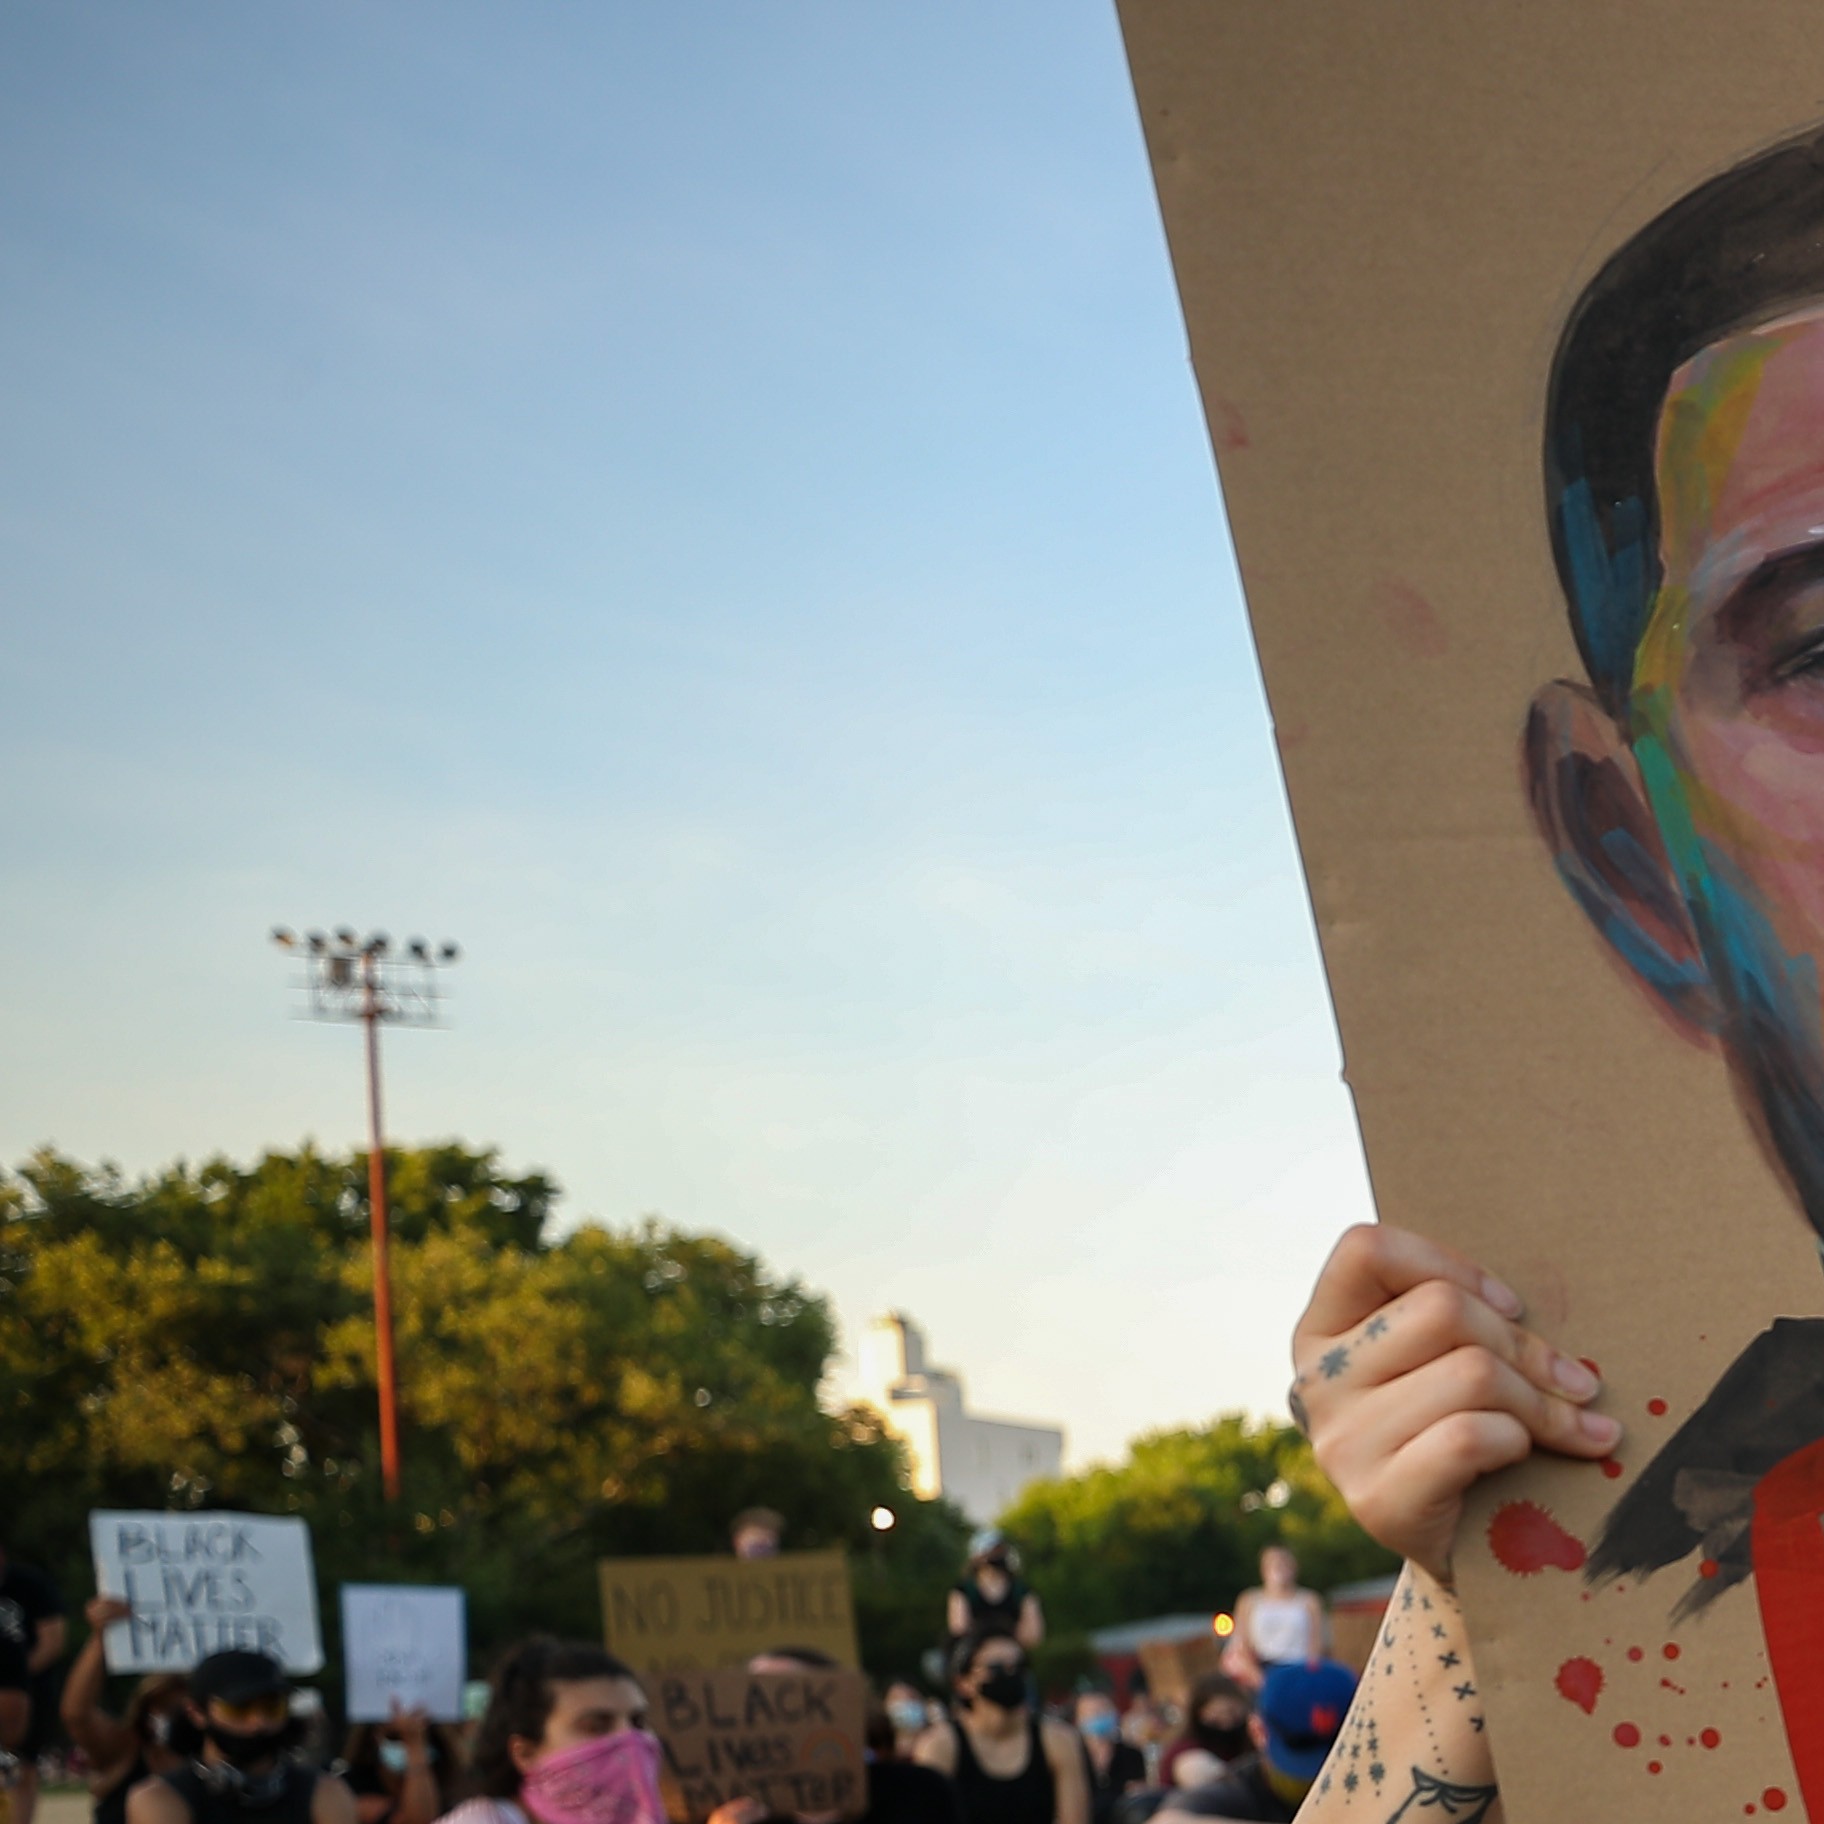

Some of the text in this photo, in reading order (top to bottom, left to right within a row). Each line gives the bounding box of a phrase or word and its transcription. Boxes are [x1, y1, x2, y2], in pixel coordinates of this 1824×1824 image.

[117, 1521, 263, 1565] BLACK
[123, 1565, 256, 1613] LIVES
[610, 1578, 680, 1637] NO
[129, 1612, 290, 1658] MATTER
[661, 1679, 837, 1732] BLACK
